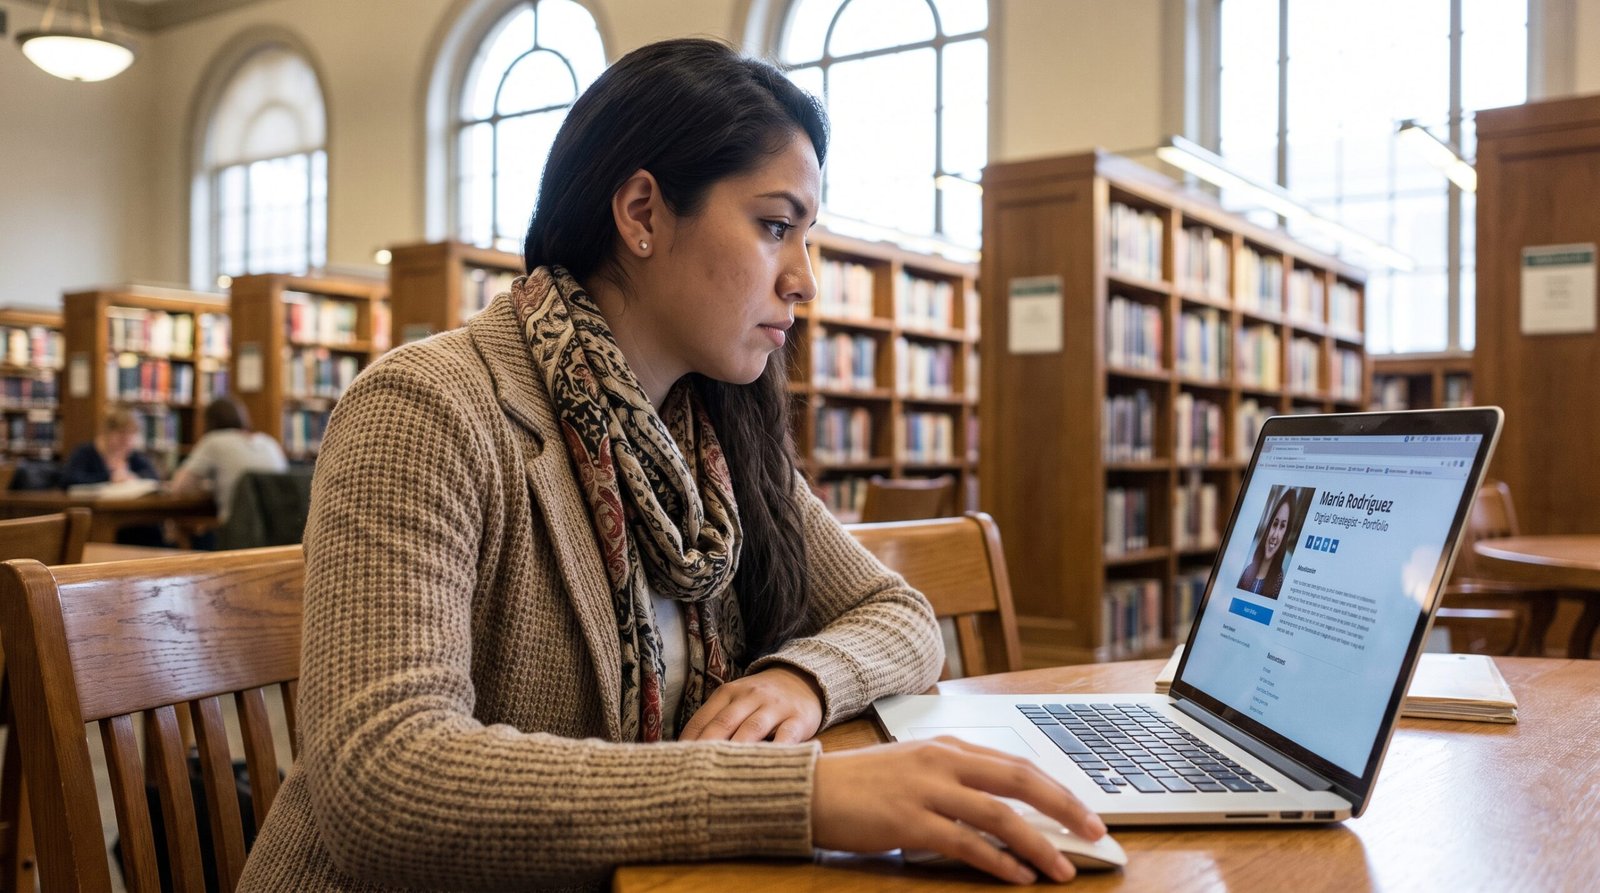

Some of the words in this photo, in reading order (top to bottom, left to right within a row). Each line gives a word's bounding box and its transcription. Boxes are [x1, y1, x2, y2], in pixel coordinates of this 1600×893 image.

[1320, 491, 1345, 507] María
[1346, 493, 1393, 515] Rodríguez
[1331, 514, 1358, 529] Strategist
[1362, 518, 1389, 532] Portfolio
